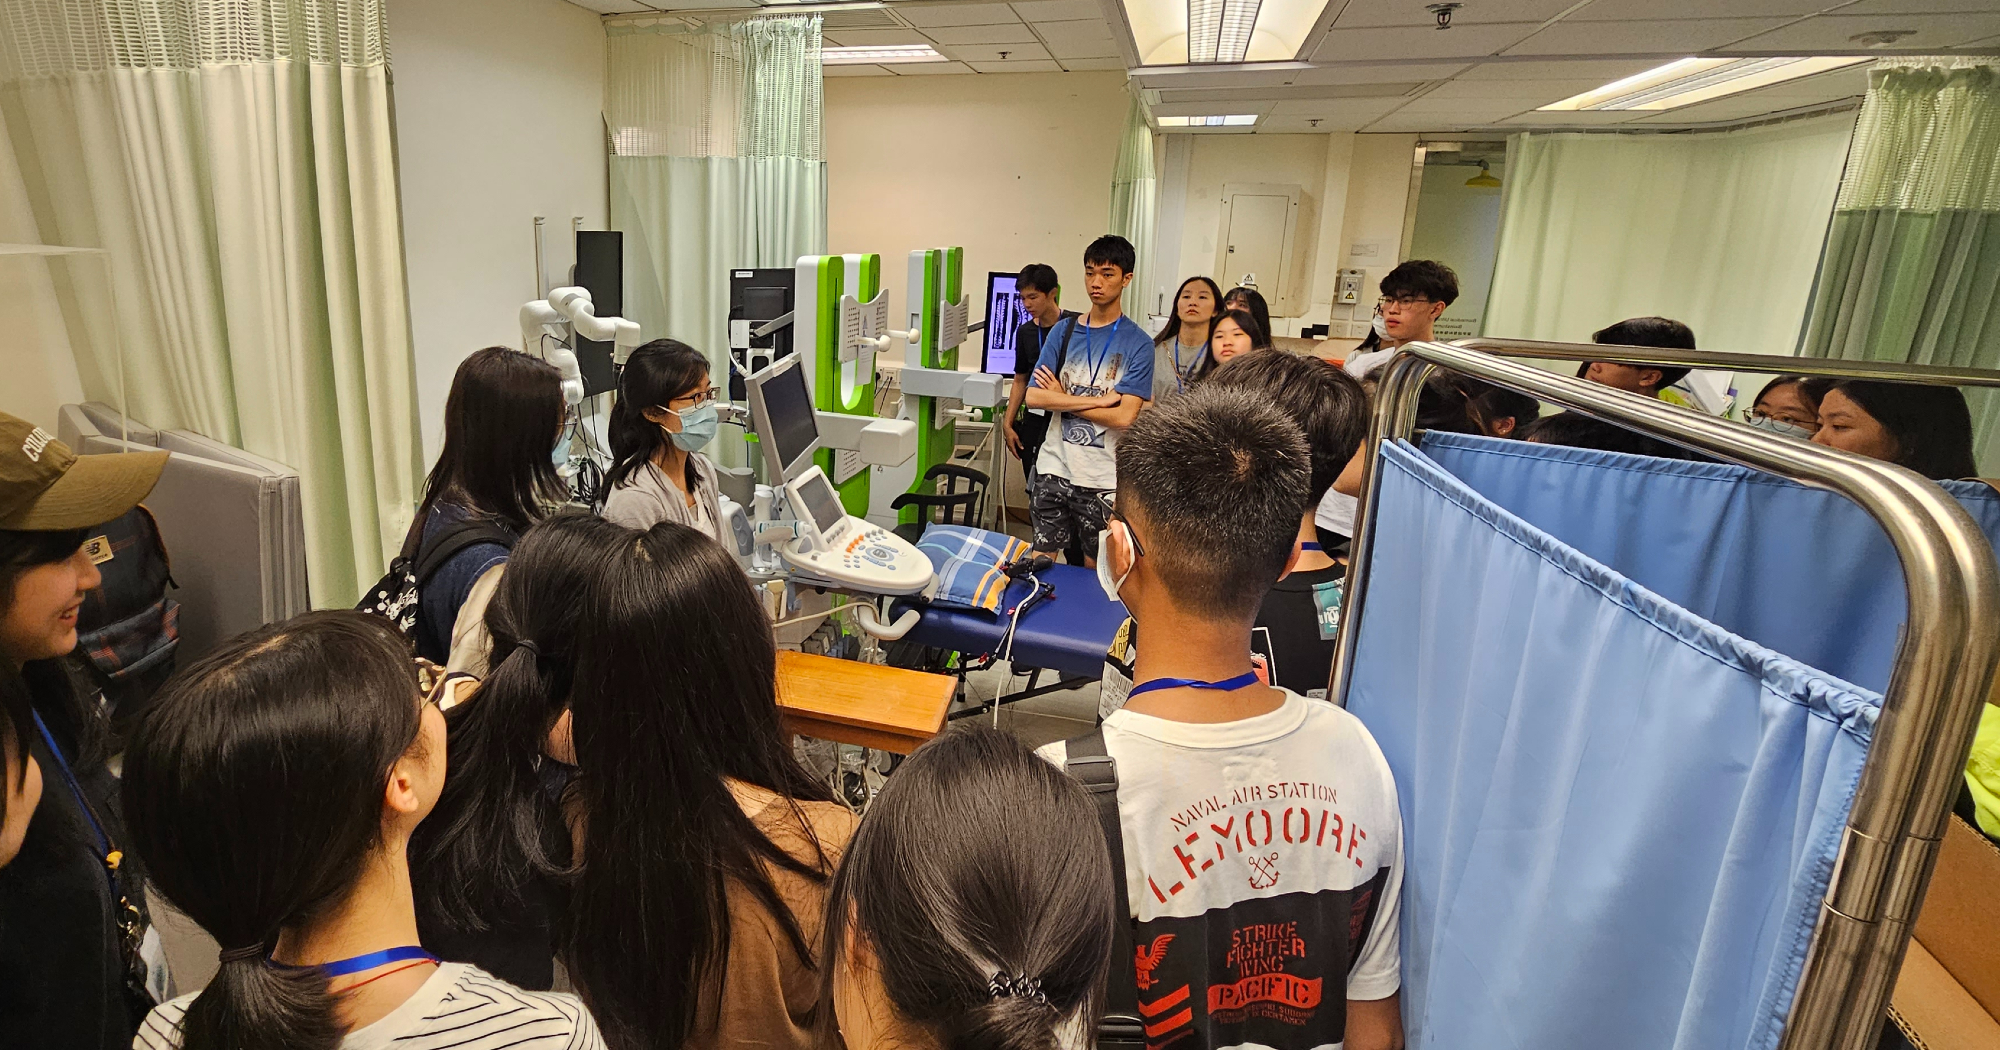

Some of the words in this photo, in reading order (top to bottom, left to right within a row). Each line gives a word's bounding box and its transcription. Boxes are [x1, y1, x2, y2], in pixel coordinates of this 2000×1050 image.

[1170, 795, 1227, 833] NAVAL
[1232, 785, 1262, 805] AIR
[1267, 781, 1337, 805] STATION
[1148, 807, 1367, 904] LEMOORE
[1232, 920, 1298, 948] STRIKE
[1225, 938, 1306, 969] FIGHTER
[1240, 955, 1284, 978] WING
[1219, 977, 1309, 1006] PACIFIC
